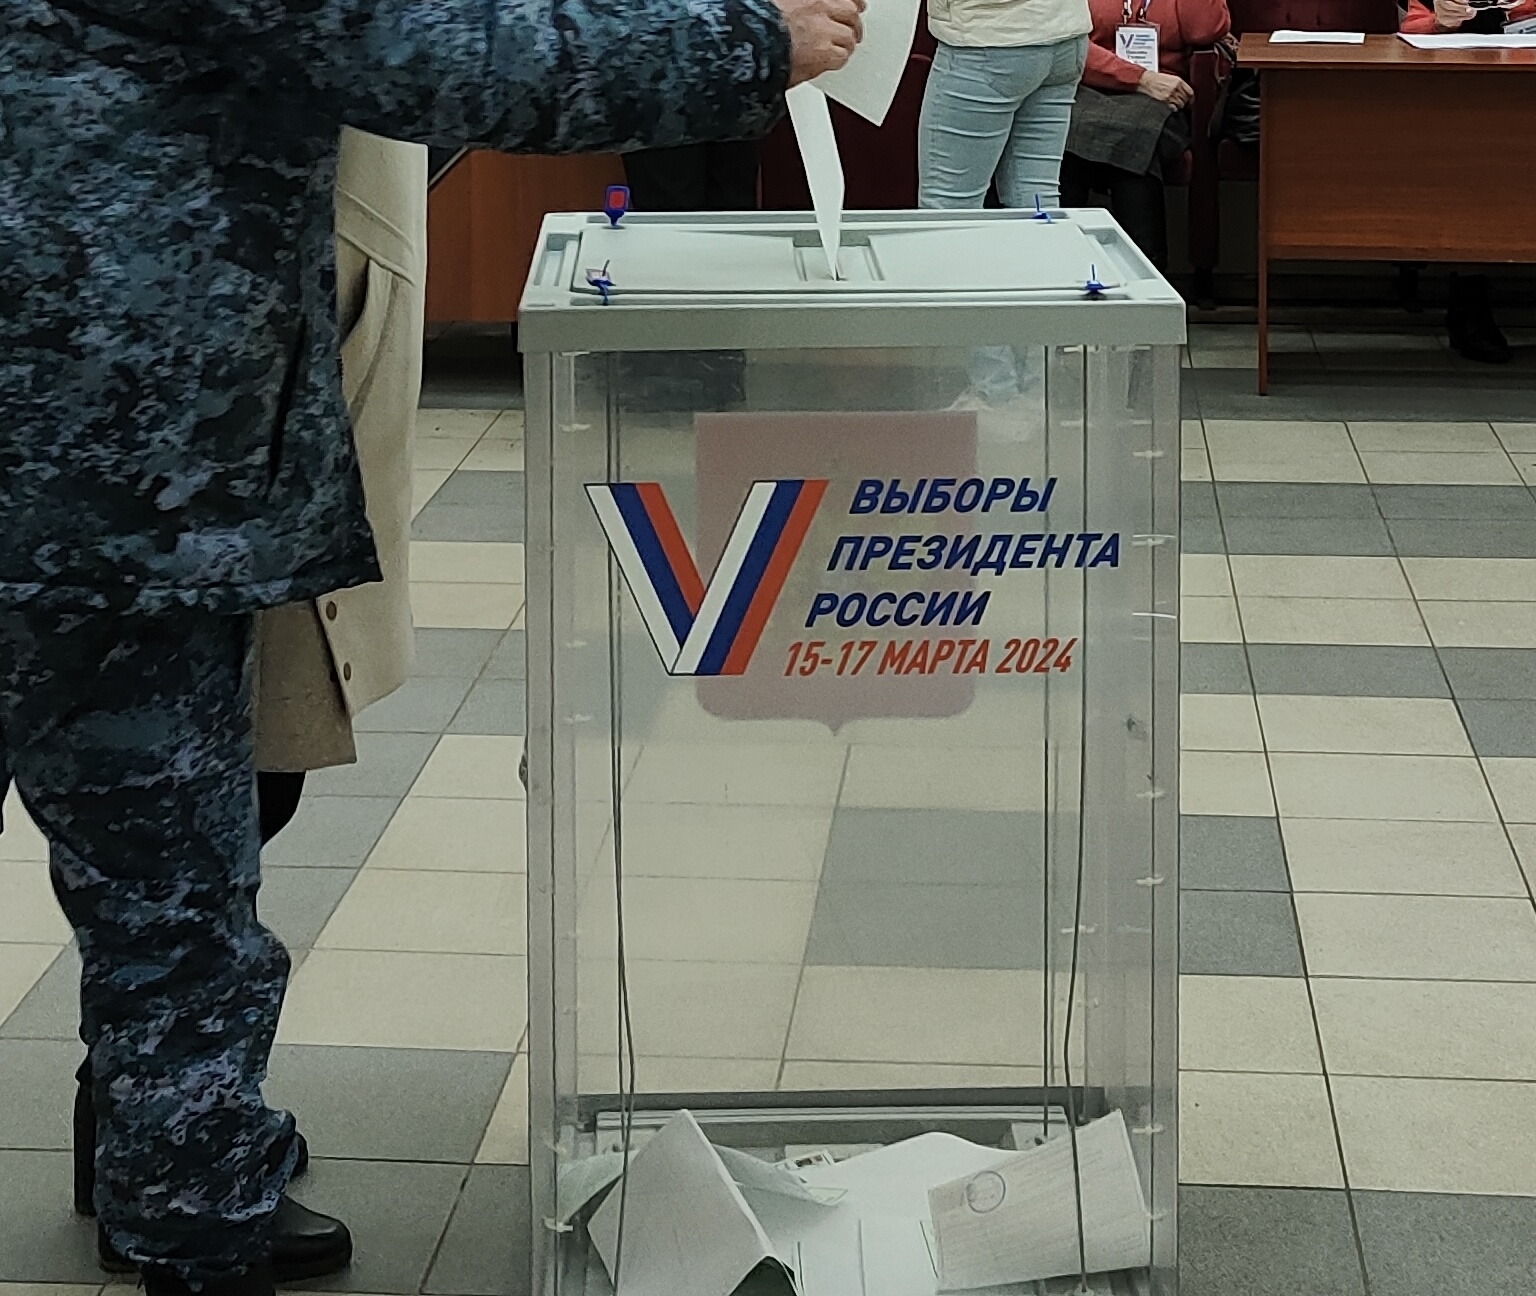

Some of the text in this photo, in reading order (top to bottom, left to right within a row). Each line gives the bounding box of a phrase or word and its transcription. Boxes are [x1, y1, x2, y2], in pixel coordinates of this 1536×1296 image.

[848, 477, 1058, 515] ВЫБОРЫ
[826, 532, 1121, 577] ПРЕЗИДЕНТА
[804, 590, 992, 629] РОССИИ
[783, 637, 1079, 678] 15-17 МАРТА 2024
